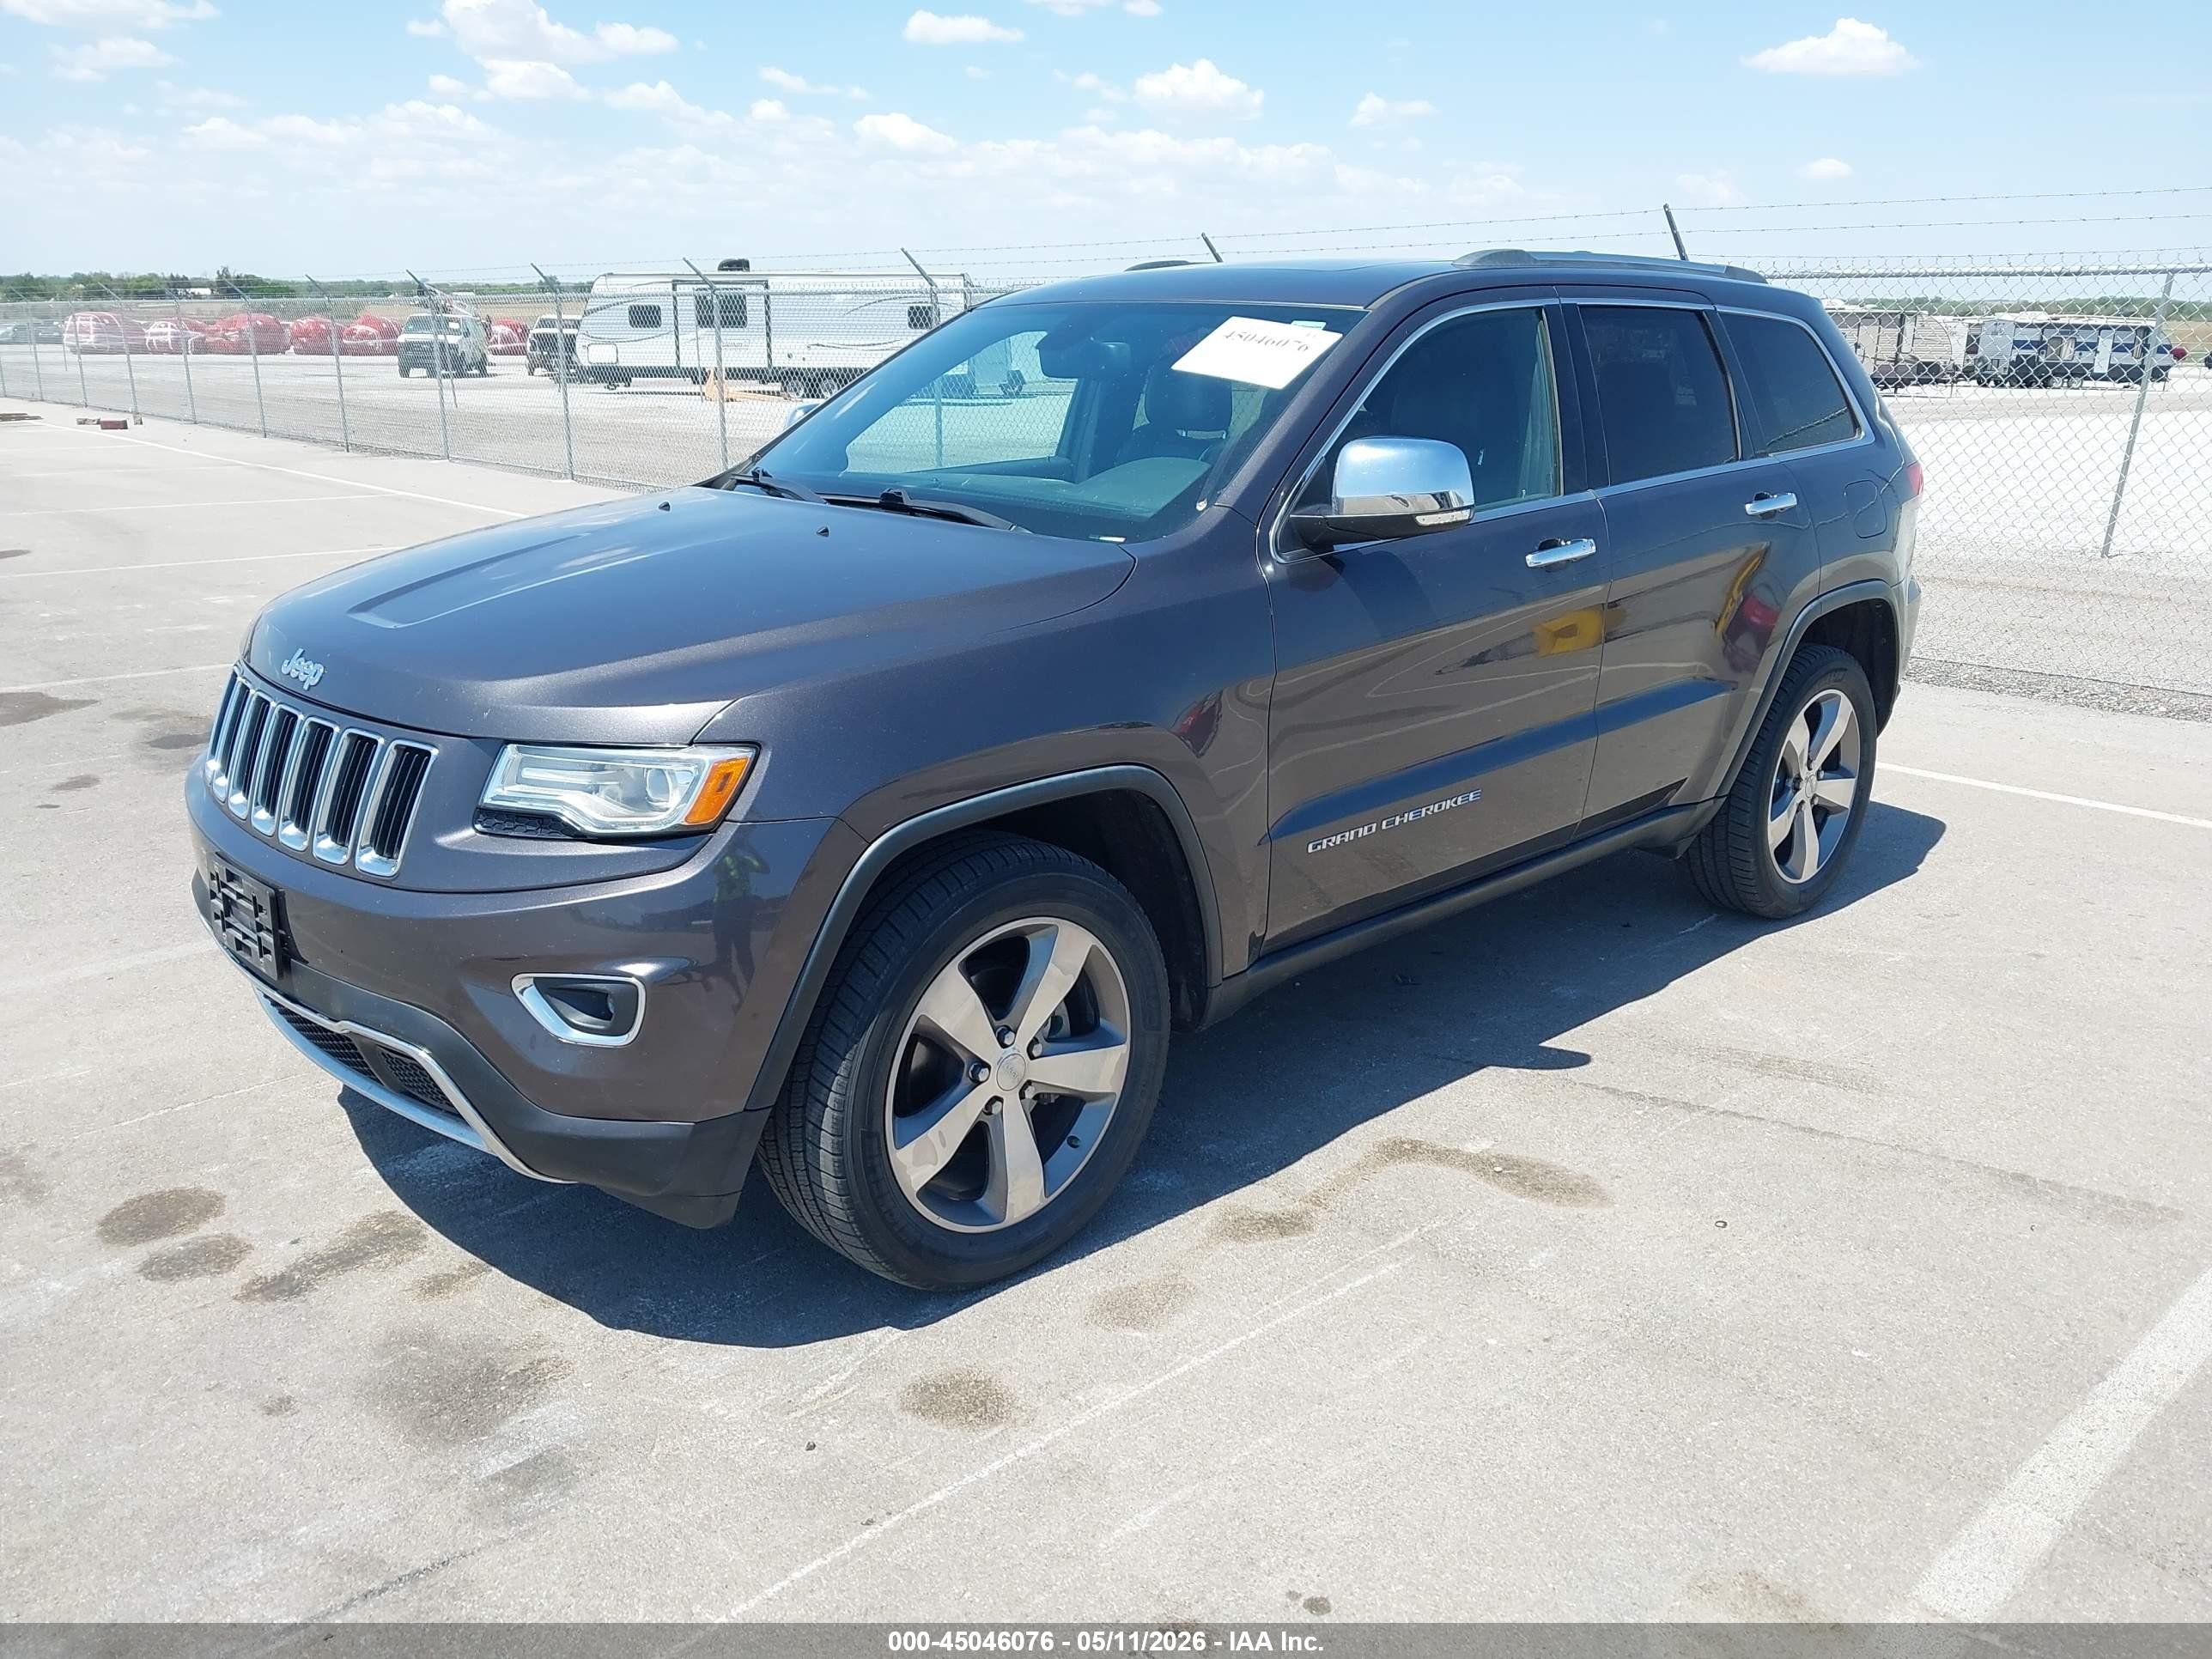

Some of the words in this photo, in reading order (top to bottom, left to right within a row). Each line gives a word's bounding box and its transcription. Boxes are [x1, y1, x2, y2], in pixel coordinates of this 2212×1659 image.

[281, 647, 324, 691] Jeep
[1307, 822, 1376, 854] GRAND
[1381, 789, 1482, 830] CHEROKEE
